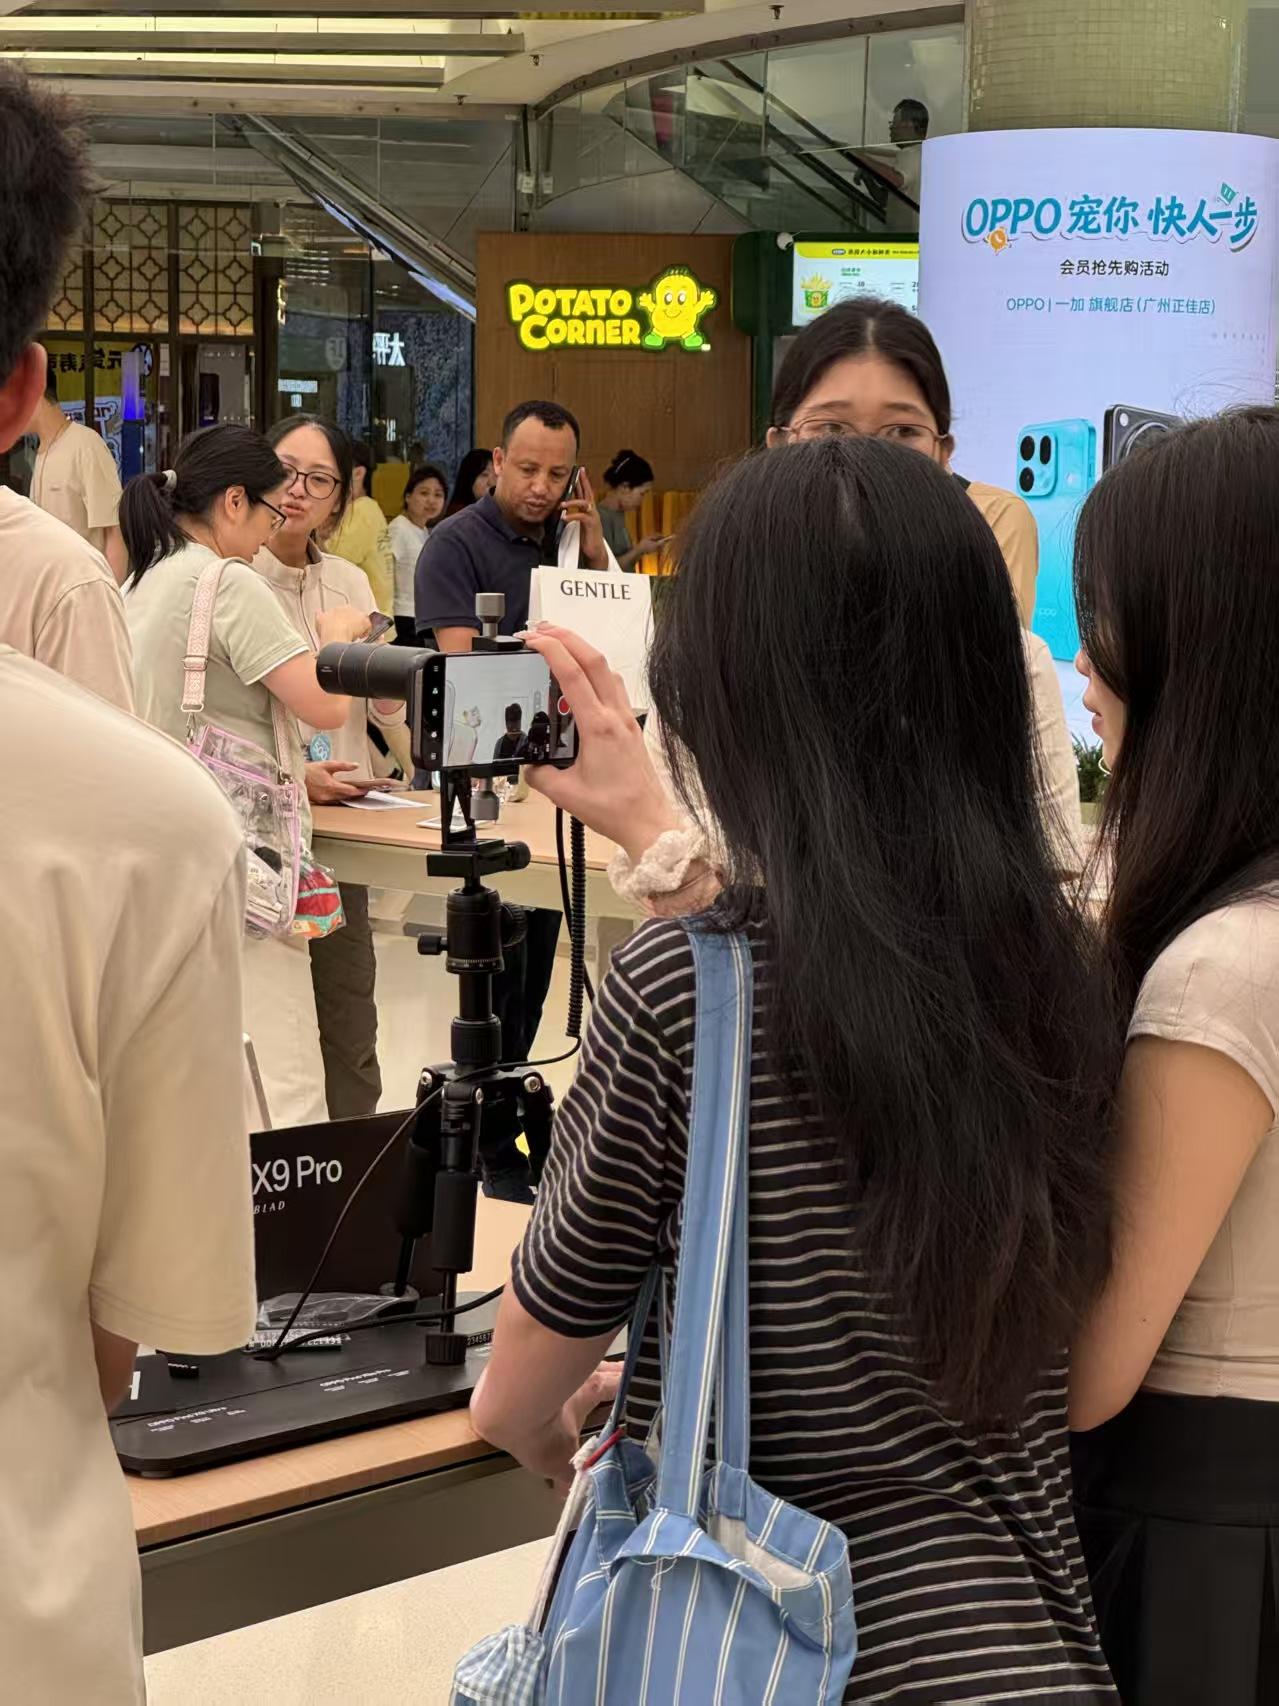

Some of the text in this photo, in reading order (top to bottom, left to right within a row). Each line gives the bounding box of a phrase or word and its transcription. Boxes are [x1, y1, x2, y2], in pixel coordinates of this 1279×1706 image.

[966, 194, 1258, 244] OPPO 宠你 快人一步
[1060, 259, 1170, 277] 会员抢先购活动
[510, 284, 633, 322] POTATO
[520, 314, 642, 349] CORNER
[560, 579, 631, 600] GENTLE
[252, 1155, 343, 1196] X9 Pro
